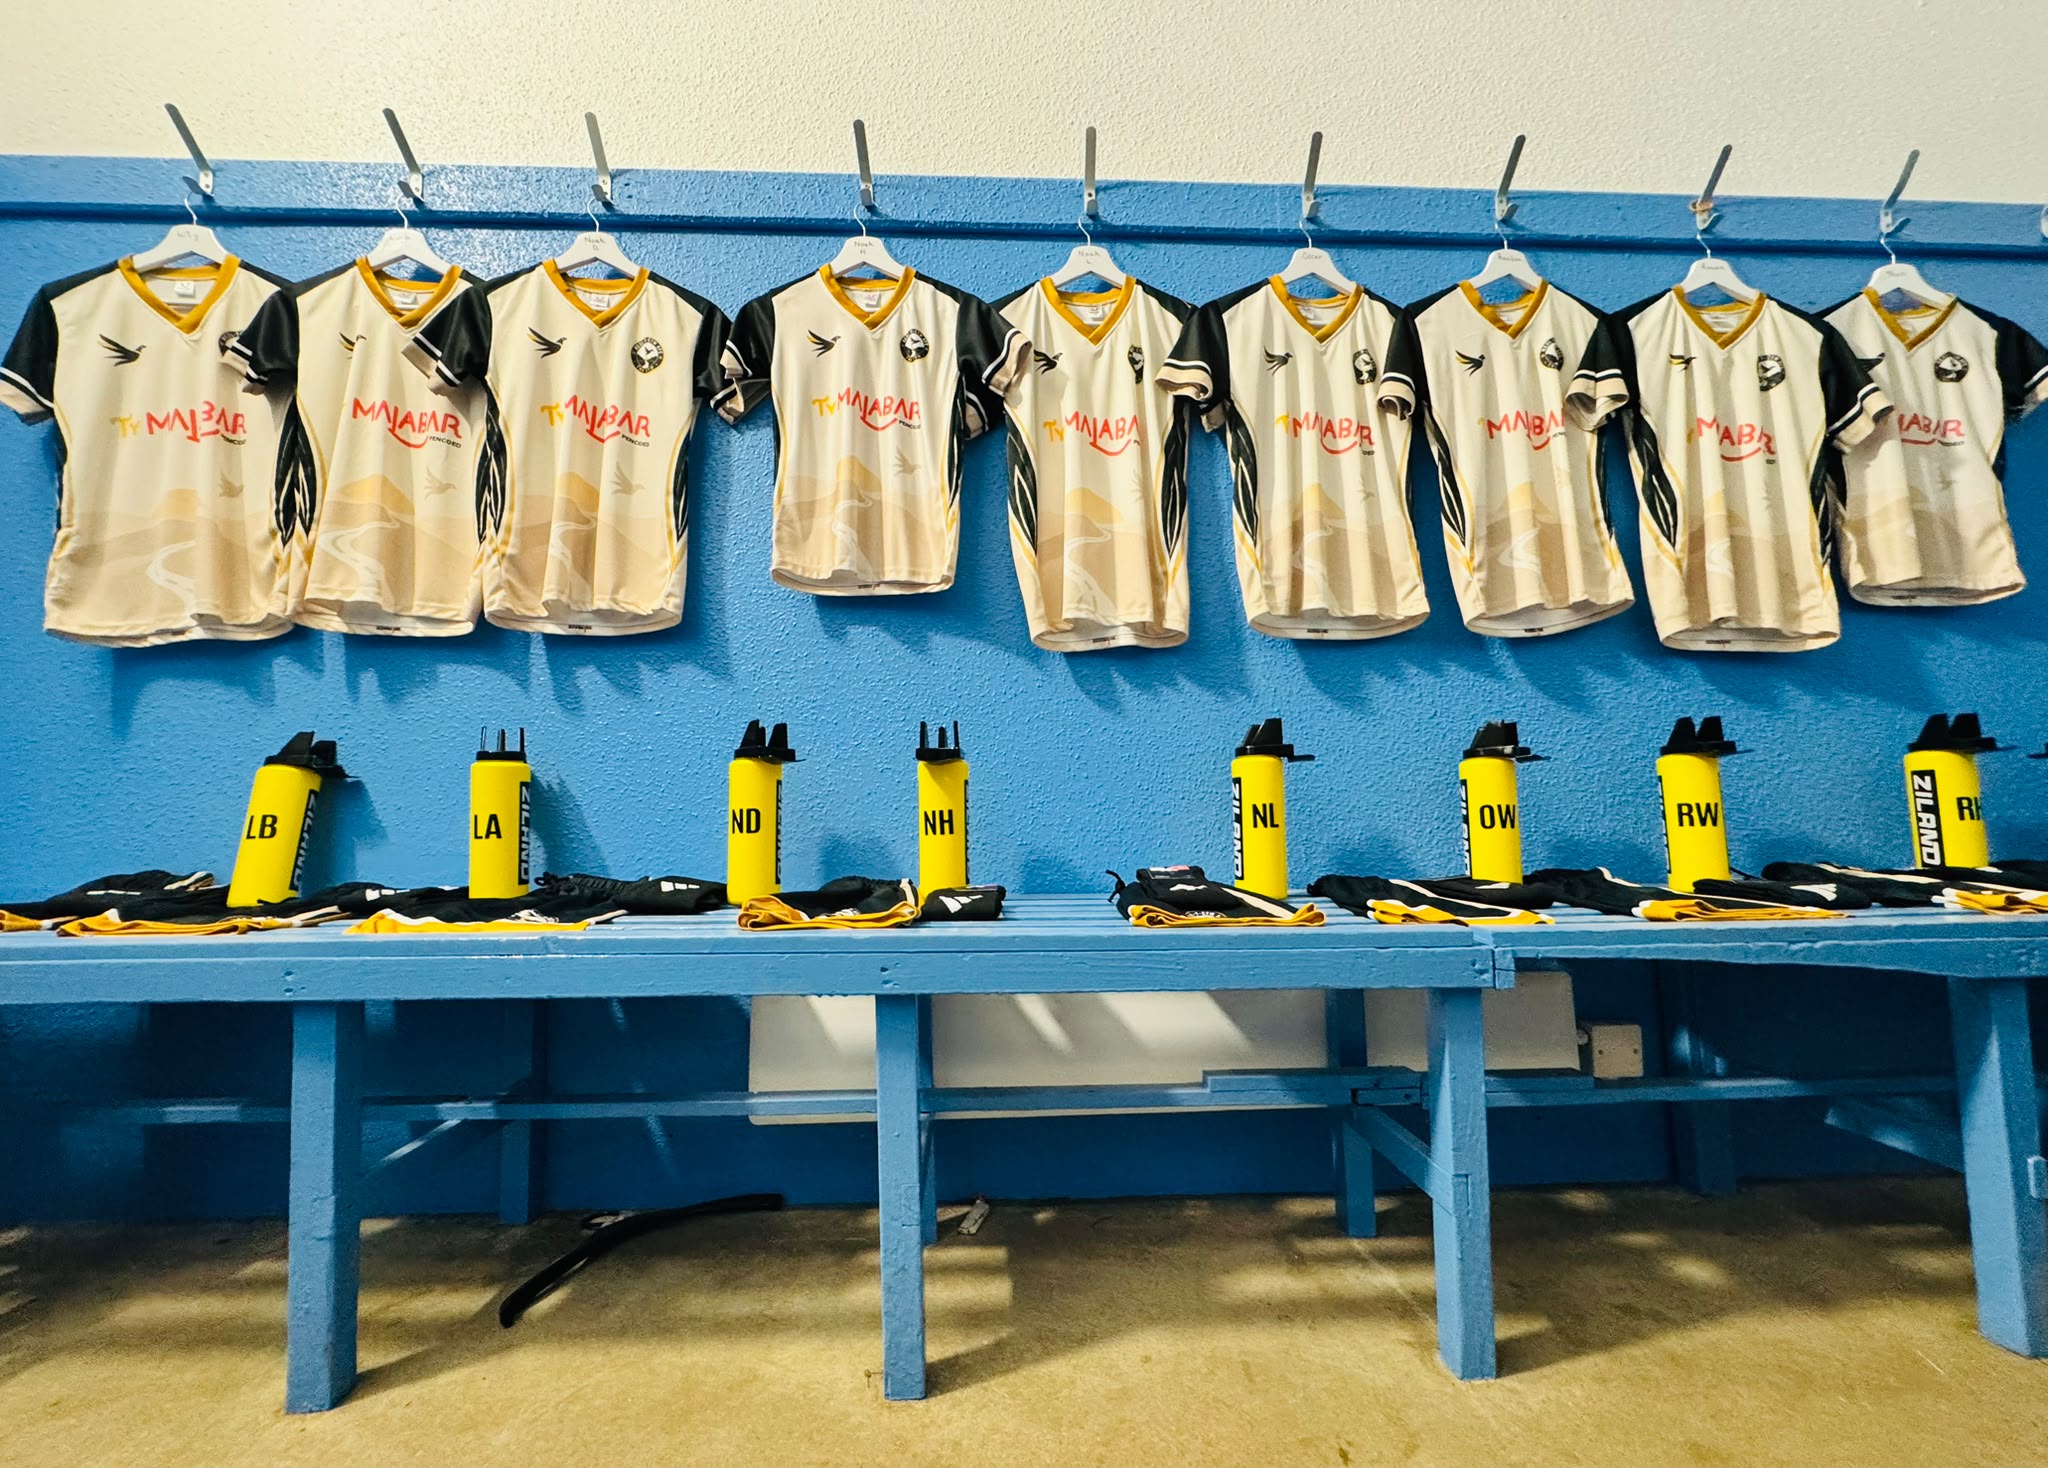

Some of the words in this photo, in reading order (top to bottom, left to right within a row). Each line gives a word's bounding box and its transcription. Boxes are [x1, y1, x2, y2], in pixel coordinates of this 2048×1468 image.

[351, 396, 463, 448] MALABAR
[246, 814, 279, 840] LB
[473, 813, 503, 840] LA
[731, 807, 762, 835] ND
[923, 808, 955, 836] NH
[1251, 802, 1280, 829] NL
[1479, 803, 1517, 830] OW
[1676, 802, 1719, 827] RW
[1912, 773, 1942, 868] ZILAND
